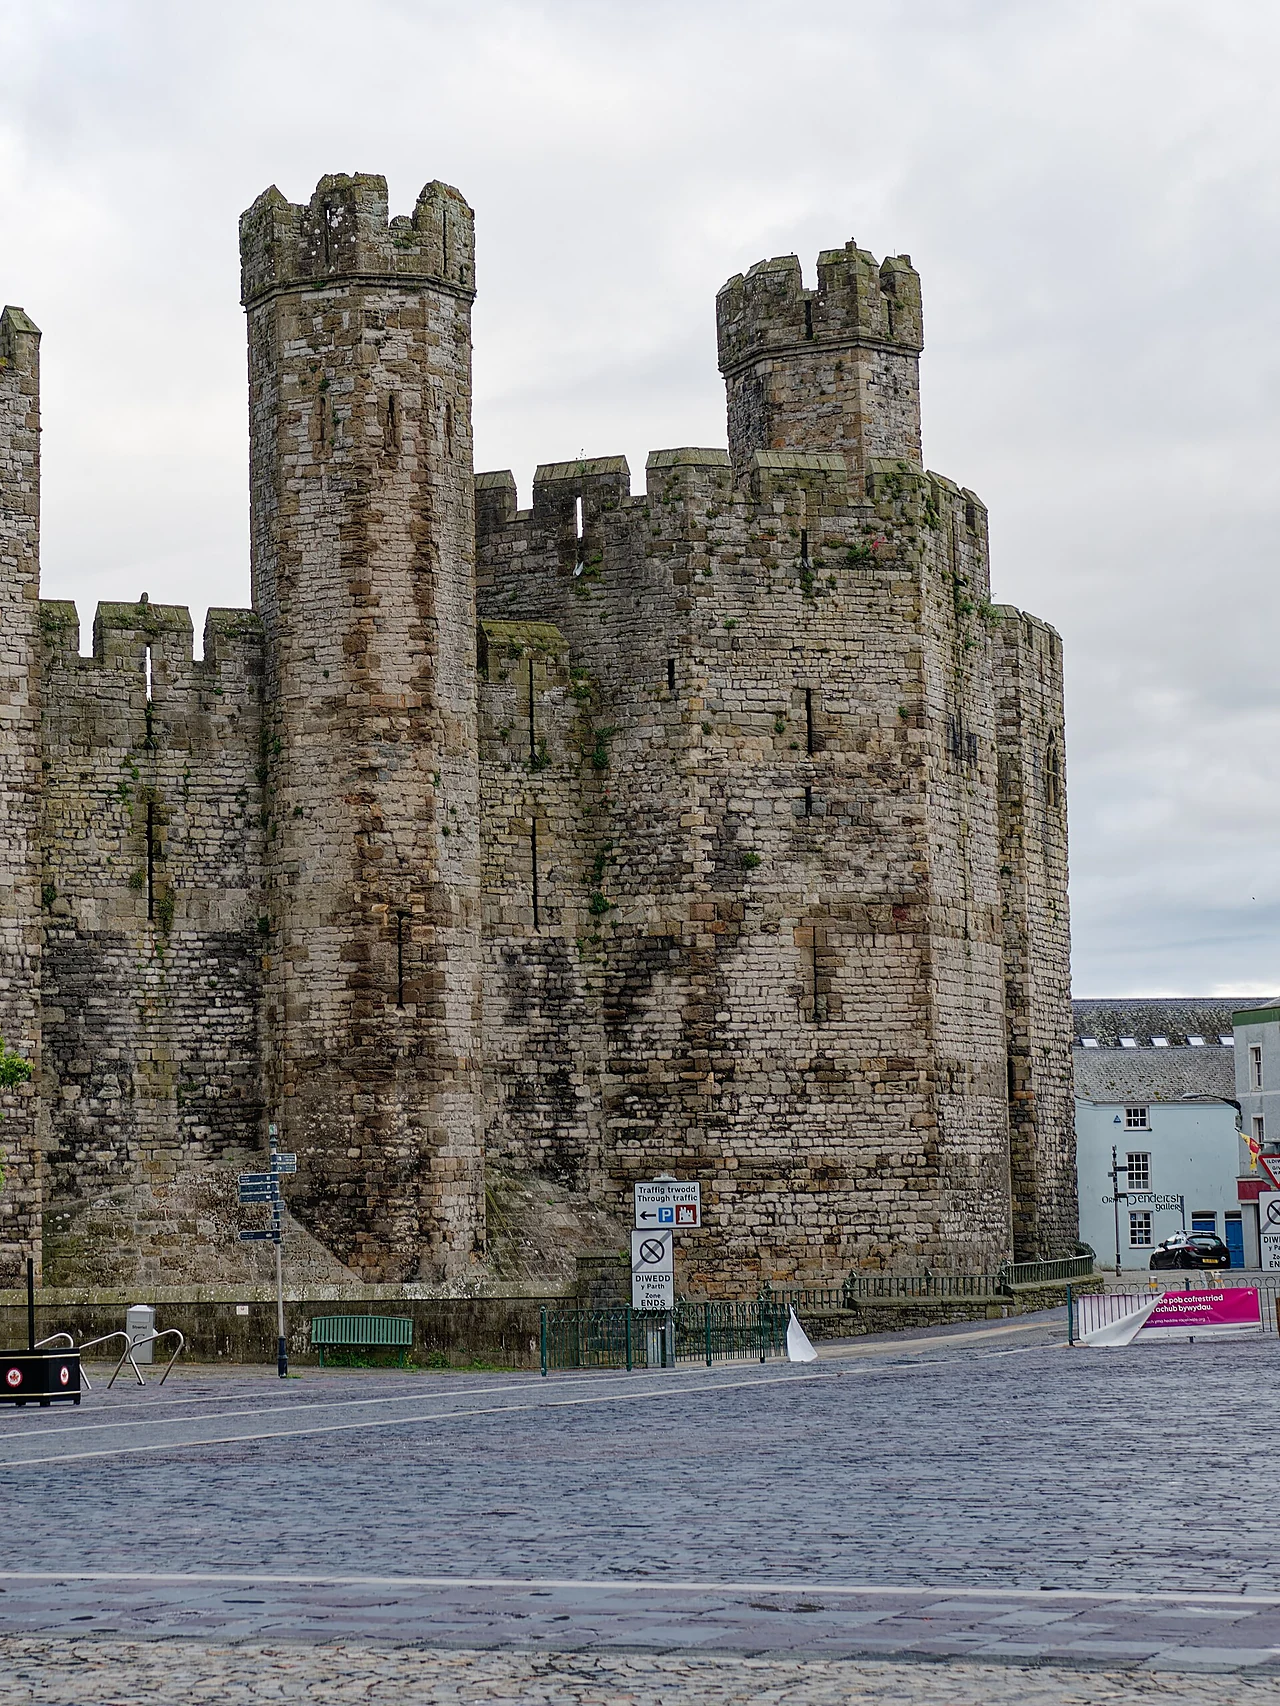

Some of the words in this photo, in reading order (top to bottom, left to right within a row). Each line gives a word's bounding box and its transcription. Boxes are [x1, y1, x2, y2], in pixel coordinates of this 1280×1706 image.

[639, 1186, 665, 1195] Traffig
[637, 1195, 670, 1203] Through
[673, 1194, 698, 1202] traffic
[662, 1209, 671, 1221] P
[1168, 1296, 1183, 1305] pob
[1184, 1294, 1224, 1303] cofrestriad
[1155, 1305, 1178, 1313] achub
